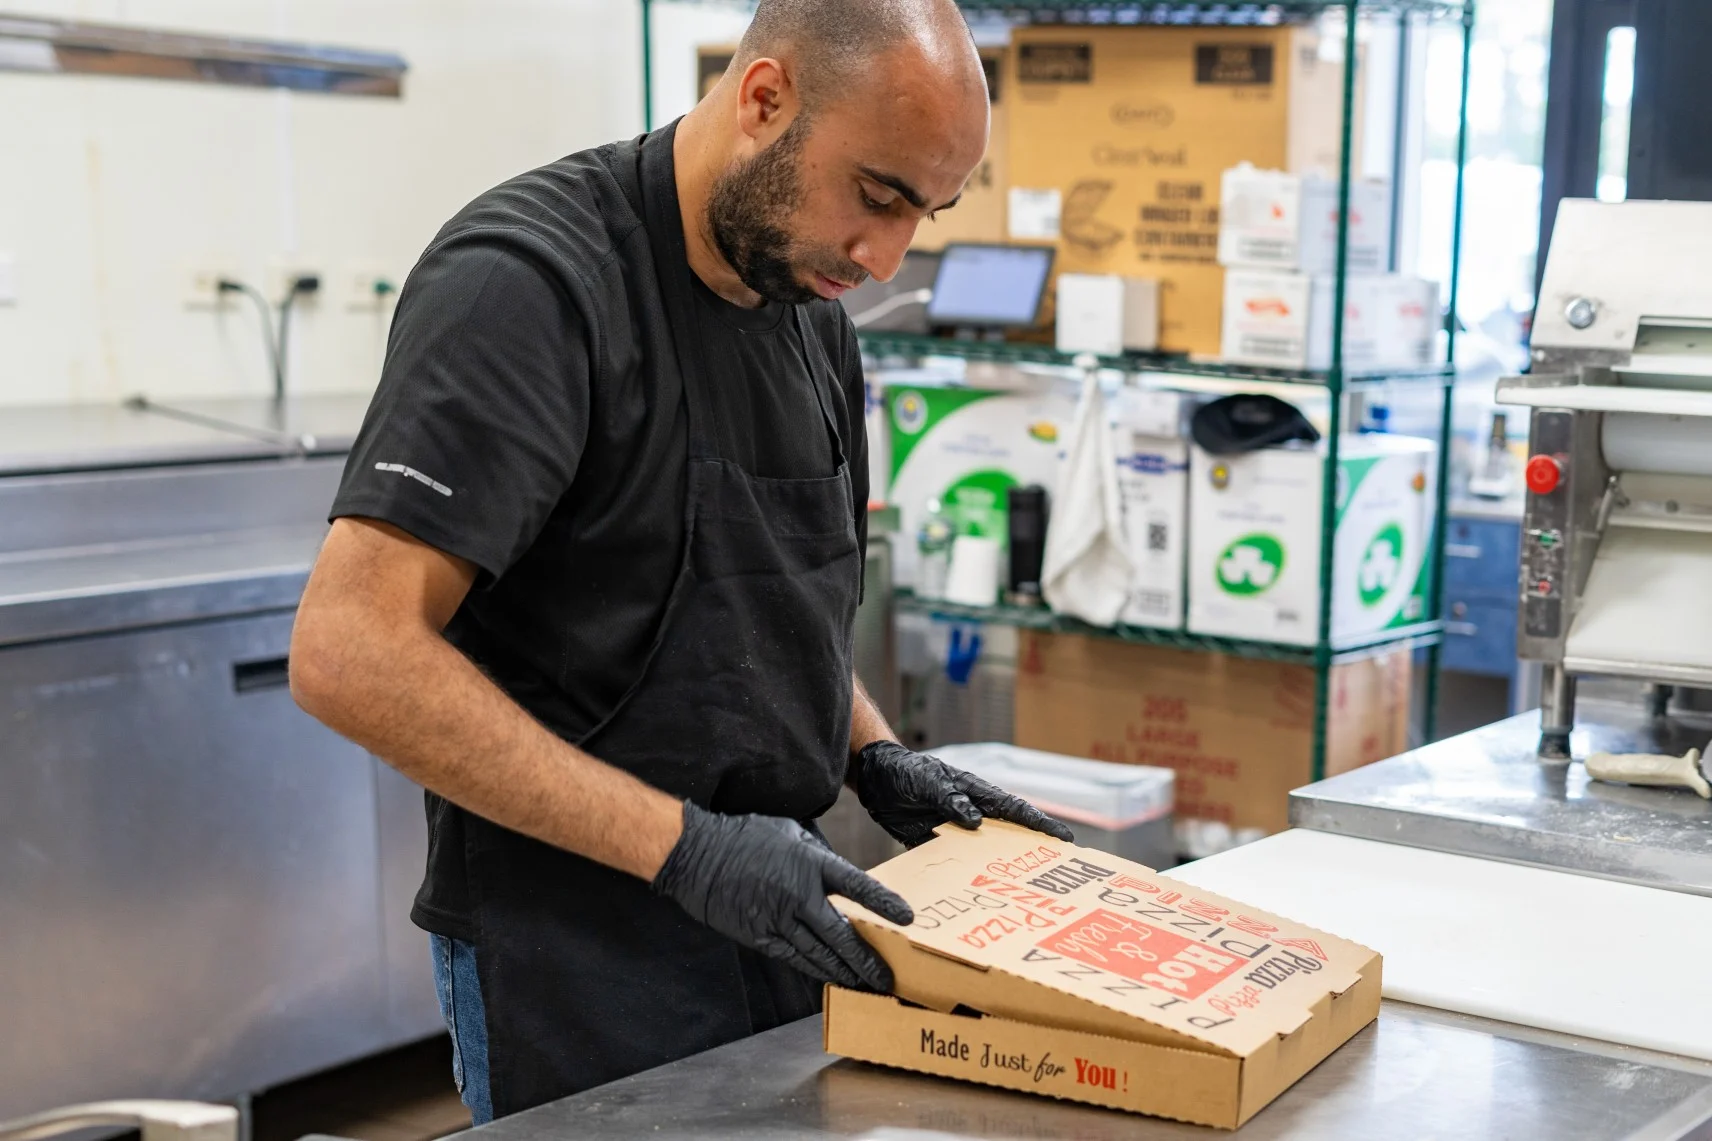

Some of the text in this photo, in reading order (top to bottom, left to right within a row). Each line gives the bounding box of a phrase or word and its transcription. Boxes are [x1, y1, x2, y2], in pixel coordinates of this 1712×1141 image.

[986, 845, 1062, 879] Pizza
[1026, 857, 1117, 895] Pizza
[970, 874, 1078, 916] PIZZA
[1108, 873, 1329, 962] PIZZA
[957, 905, 1058, 949] Pizza
[1054, 913, 1153, 963] Fresh
[1097, 885, 1272, 958] Pizza
[1109, 941, 1159, 963] &
[1141, 943, 1237, 992] Hot
[1244, 949, 1323, 989] Pizza
[1021, 948, 1235, 1029] PIZZA
[920, 1028, 969, 1061] Made
[980, 1043, 1033, 1073] Just
[1033, 1052, 1067, 1083] for
